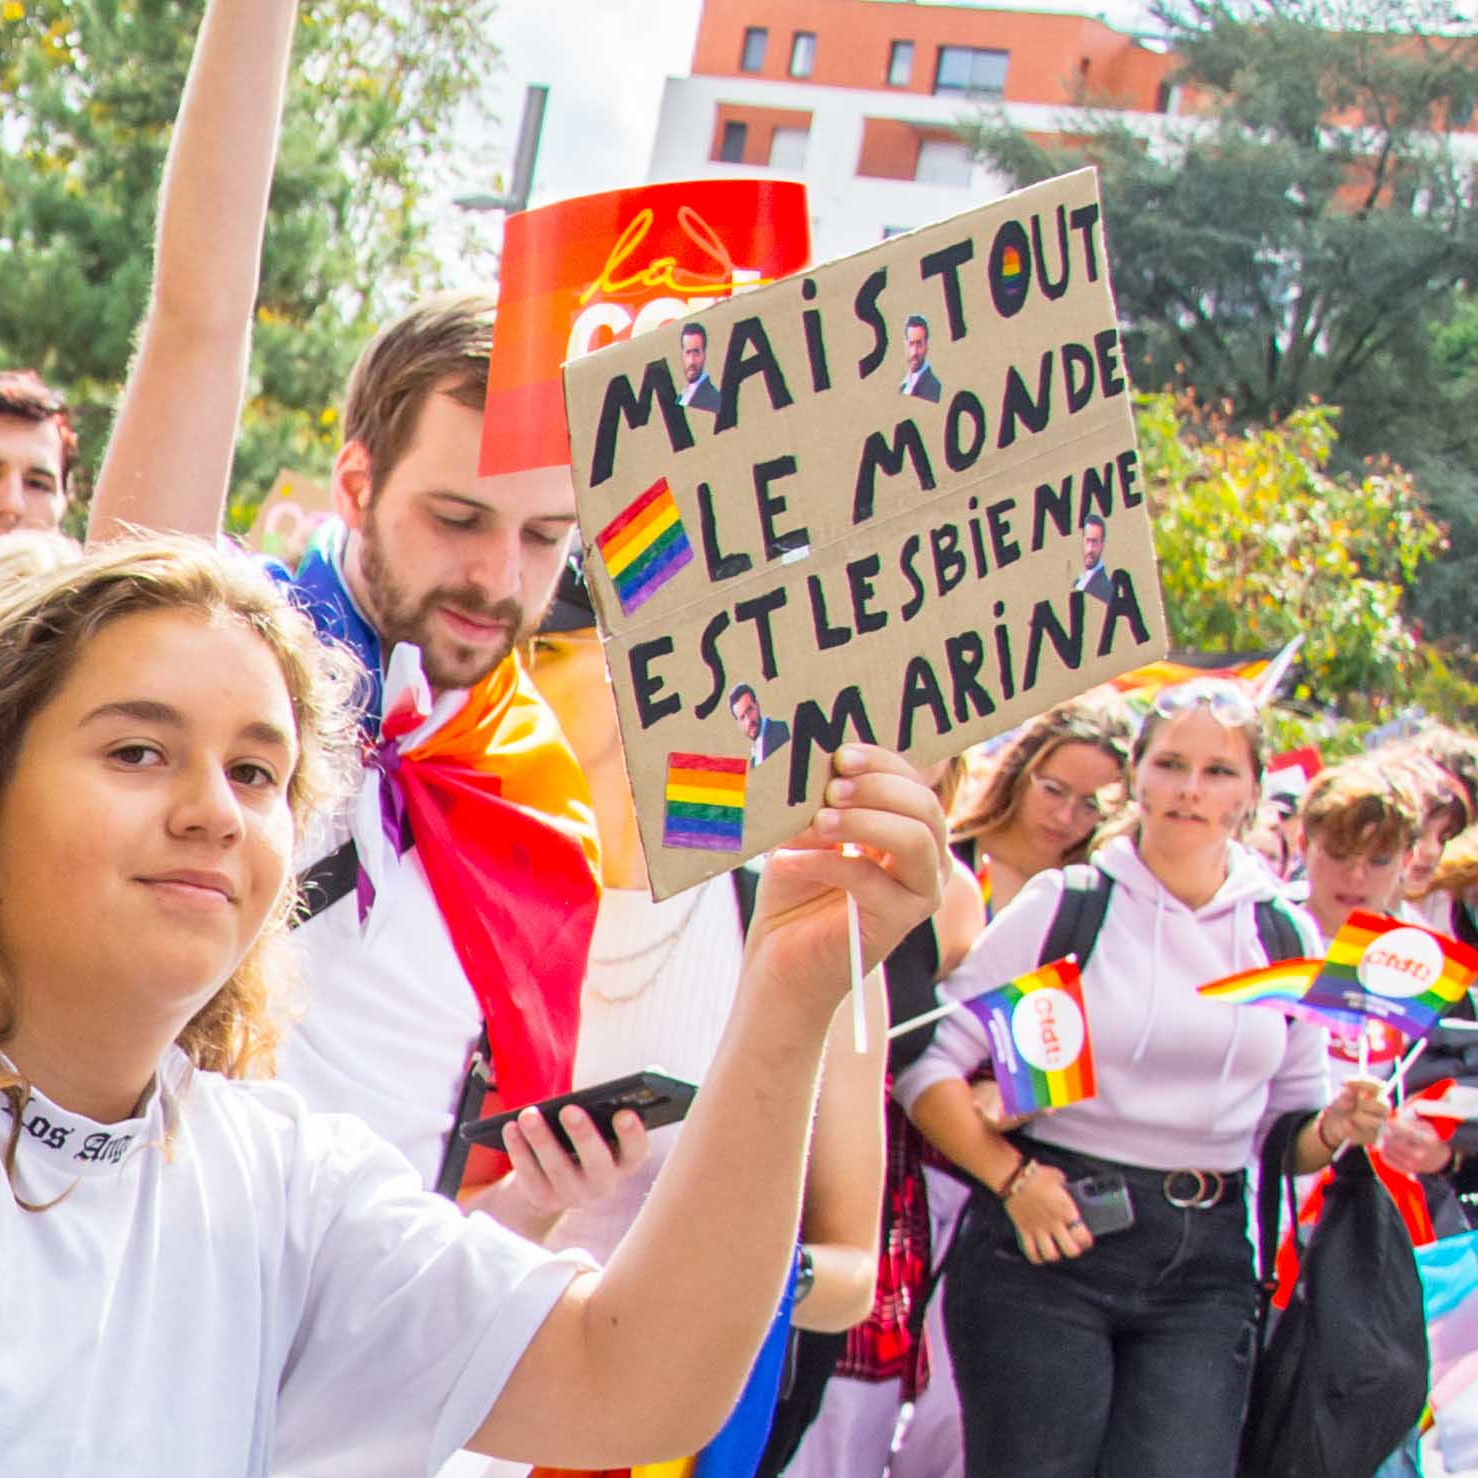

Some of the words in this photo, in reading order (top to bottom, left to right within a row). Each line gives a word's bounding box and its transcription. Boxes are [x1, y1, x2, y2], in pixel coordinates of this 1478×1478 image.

[920, 203, 1099, 341] TOUT
[696, 455, 810, 582] LE
[852, 328, 1126, 525] MONDE
[629, 586, 787, 729] EST
